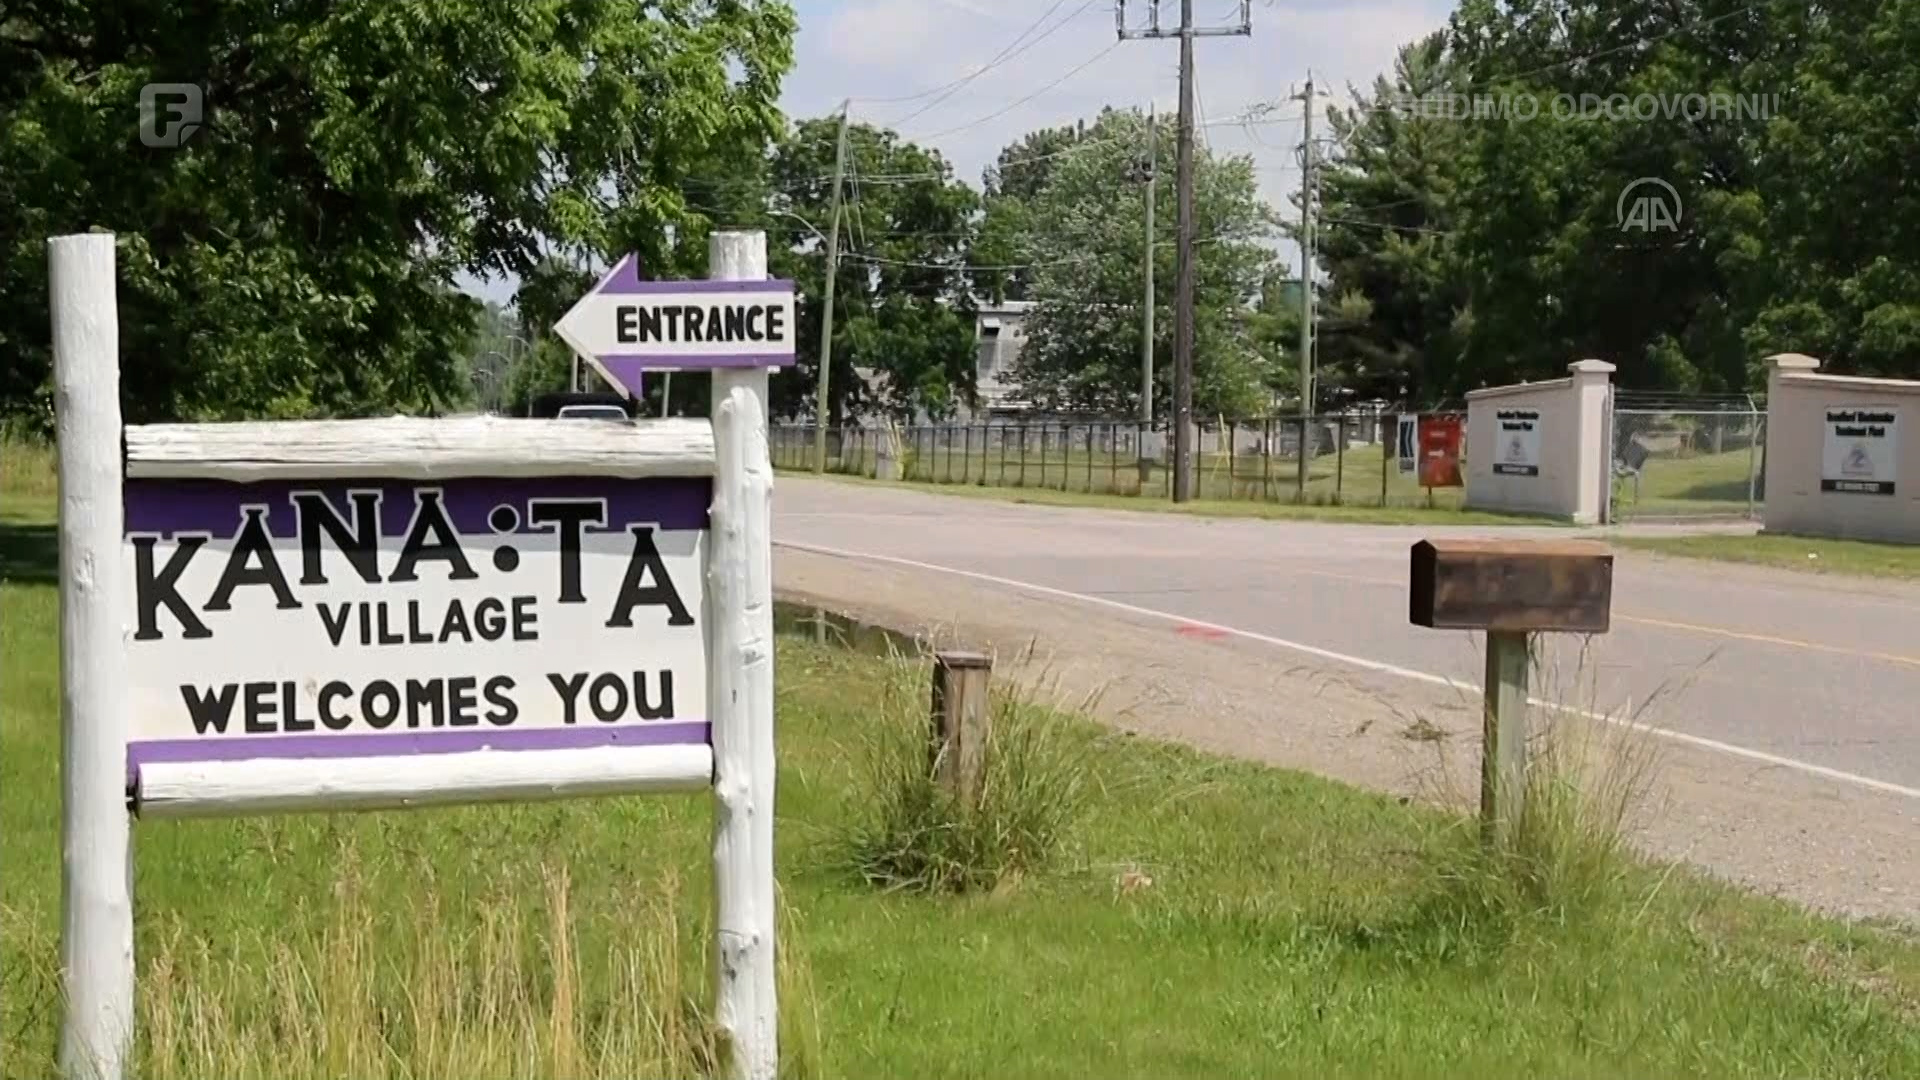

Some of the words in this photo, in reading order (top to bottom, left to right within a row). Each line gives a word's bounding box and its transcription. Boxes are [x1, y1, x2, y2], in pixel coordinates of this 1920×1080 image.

[616, 304, 784, 343] ENTRANCE
[316, 596, 540, 646] VILLAGE
[180, 675, 519, 734] WELCOMES
[547, 668, 675, 724] YOU
